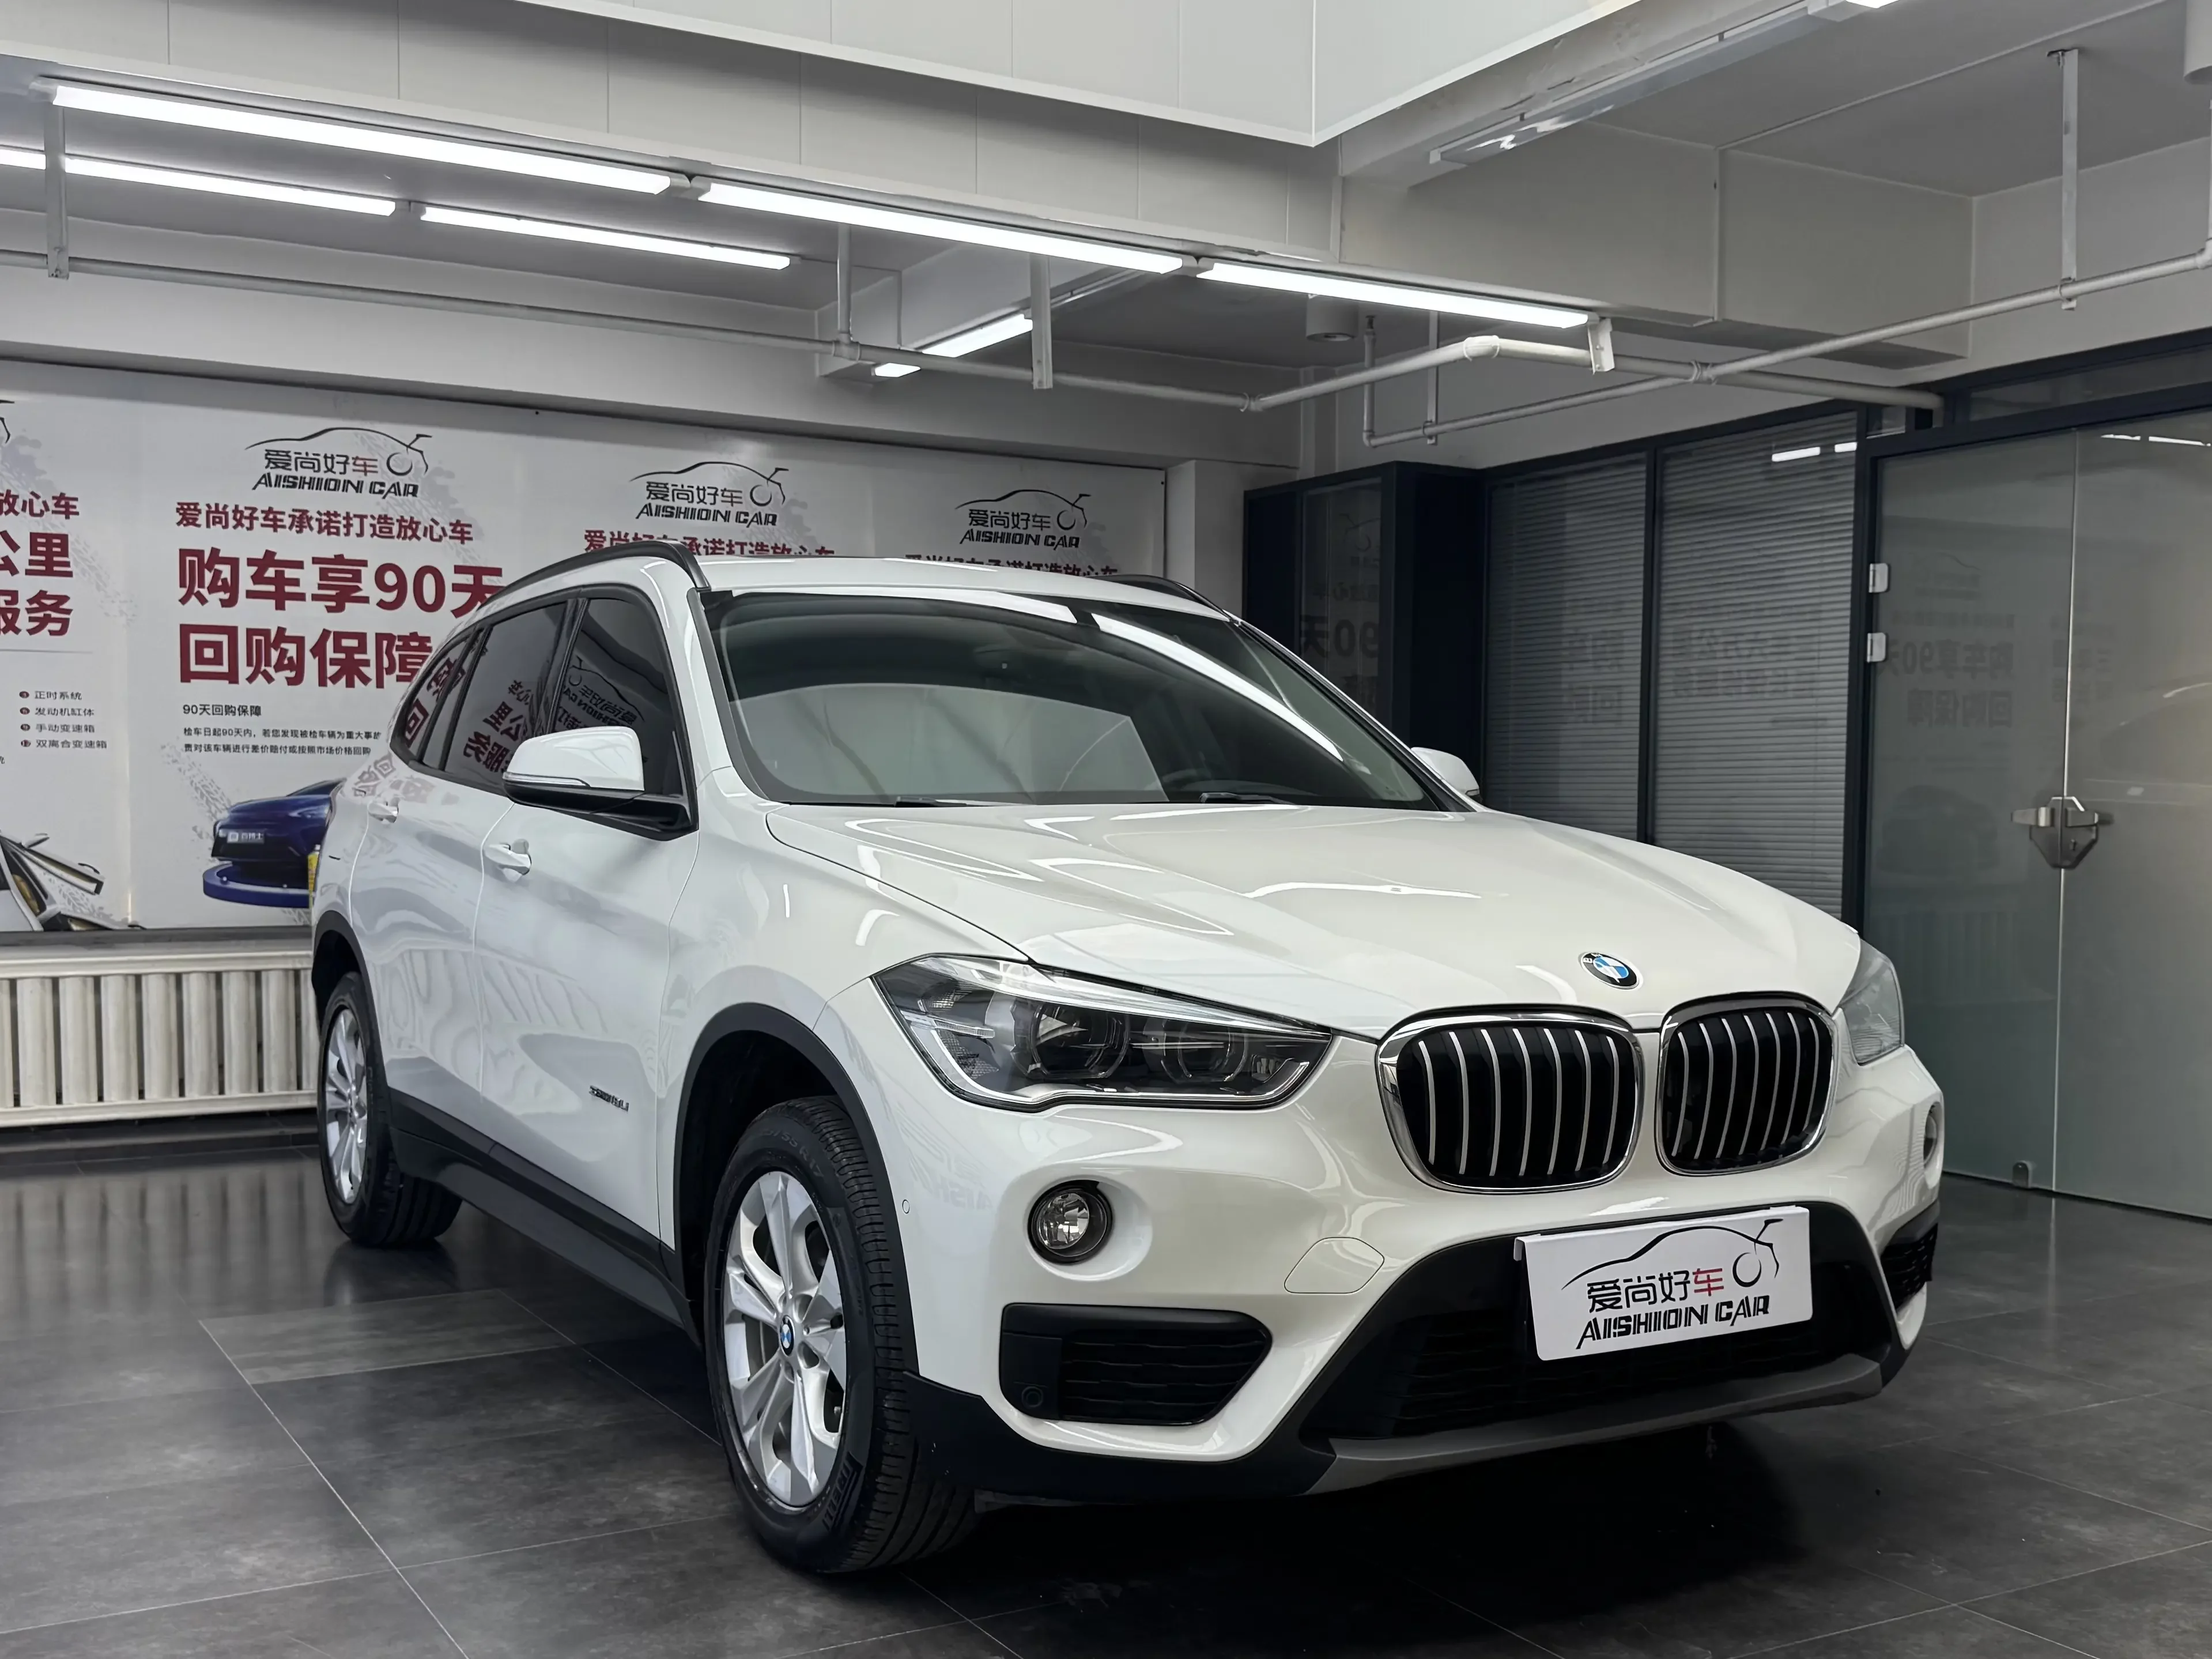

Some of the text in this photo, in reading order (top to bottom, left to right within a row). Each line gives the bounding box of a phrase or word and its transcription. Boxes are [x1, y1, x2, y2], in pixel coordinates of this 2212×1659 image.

[264, 449, 378, 476] 爱尚好车
[252, 472, 419, 499] AISHION CAR
[645, 481, 743, 507] 爱尚好车
[175, 502, 473, 545] 爱尚好车承诺打造放心车
[635, 503, 777, 528] AISHION CAR
[968, 509, 1051, 530] 爱尚好车
[960, 528, 1079, 551] AISHION CAR
[178, 547, 505, 619] 购车享90天
[179, 624, 433, 689] 回购保障
[34, 691, 82, 700] 正时系统
[183, 704, 261, 717] 90天回购保障
[35, 723, 95, 733] 手动变速箱
[1587, 1268, 1724, 1313] 爱尚好车
[1576, 1295, 1770, 1350] AISHION CAR
